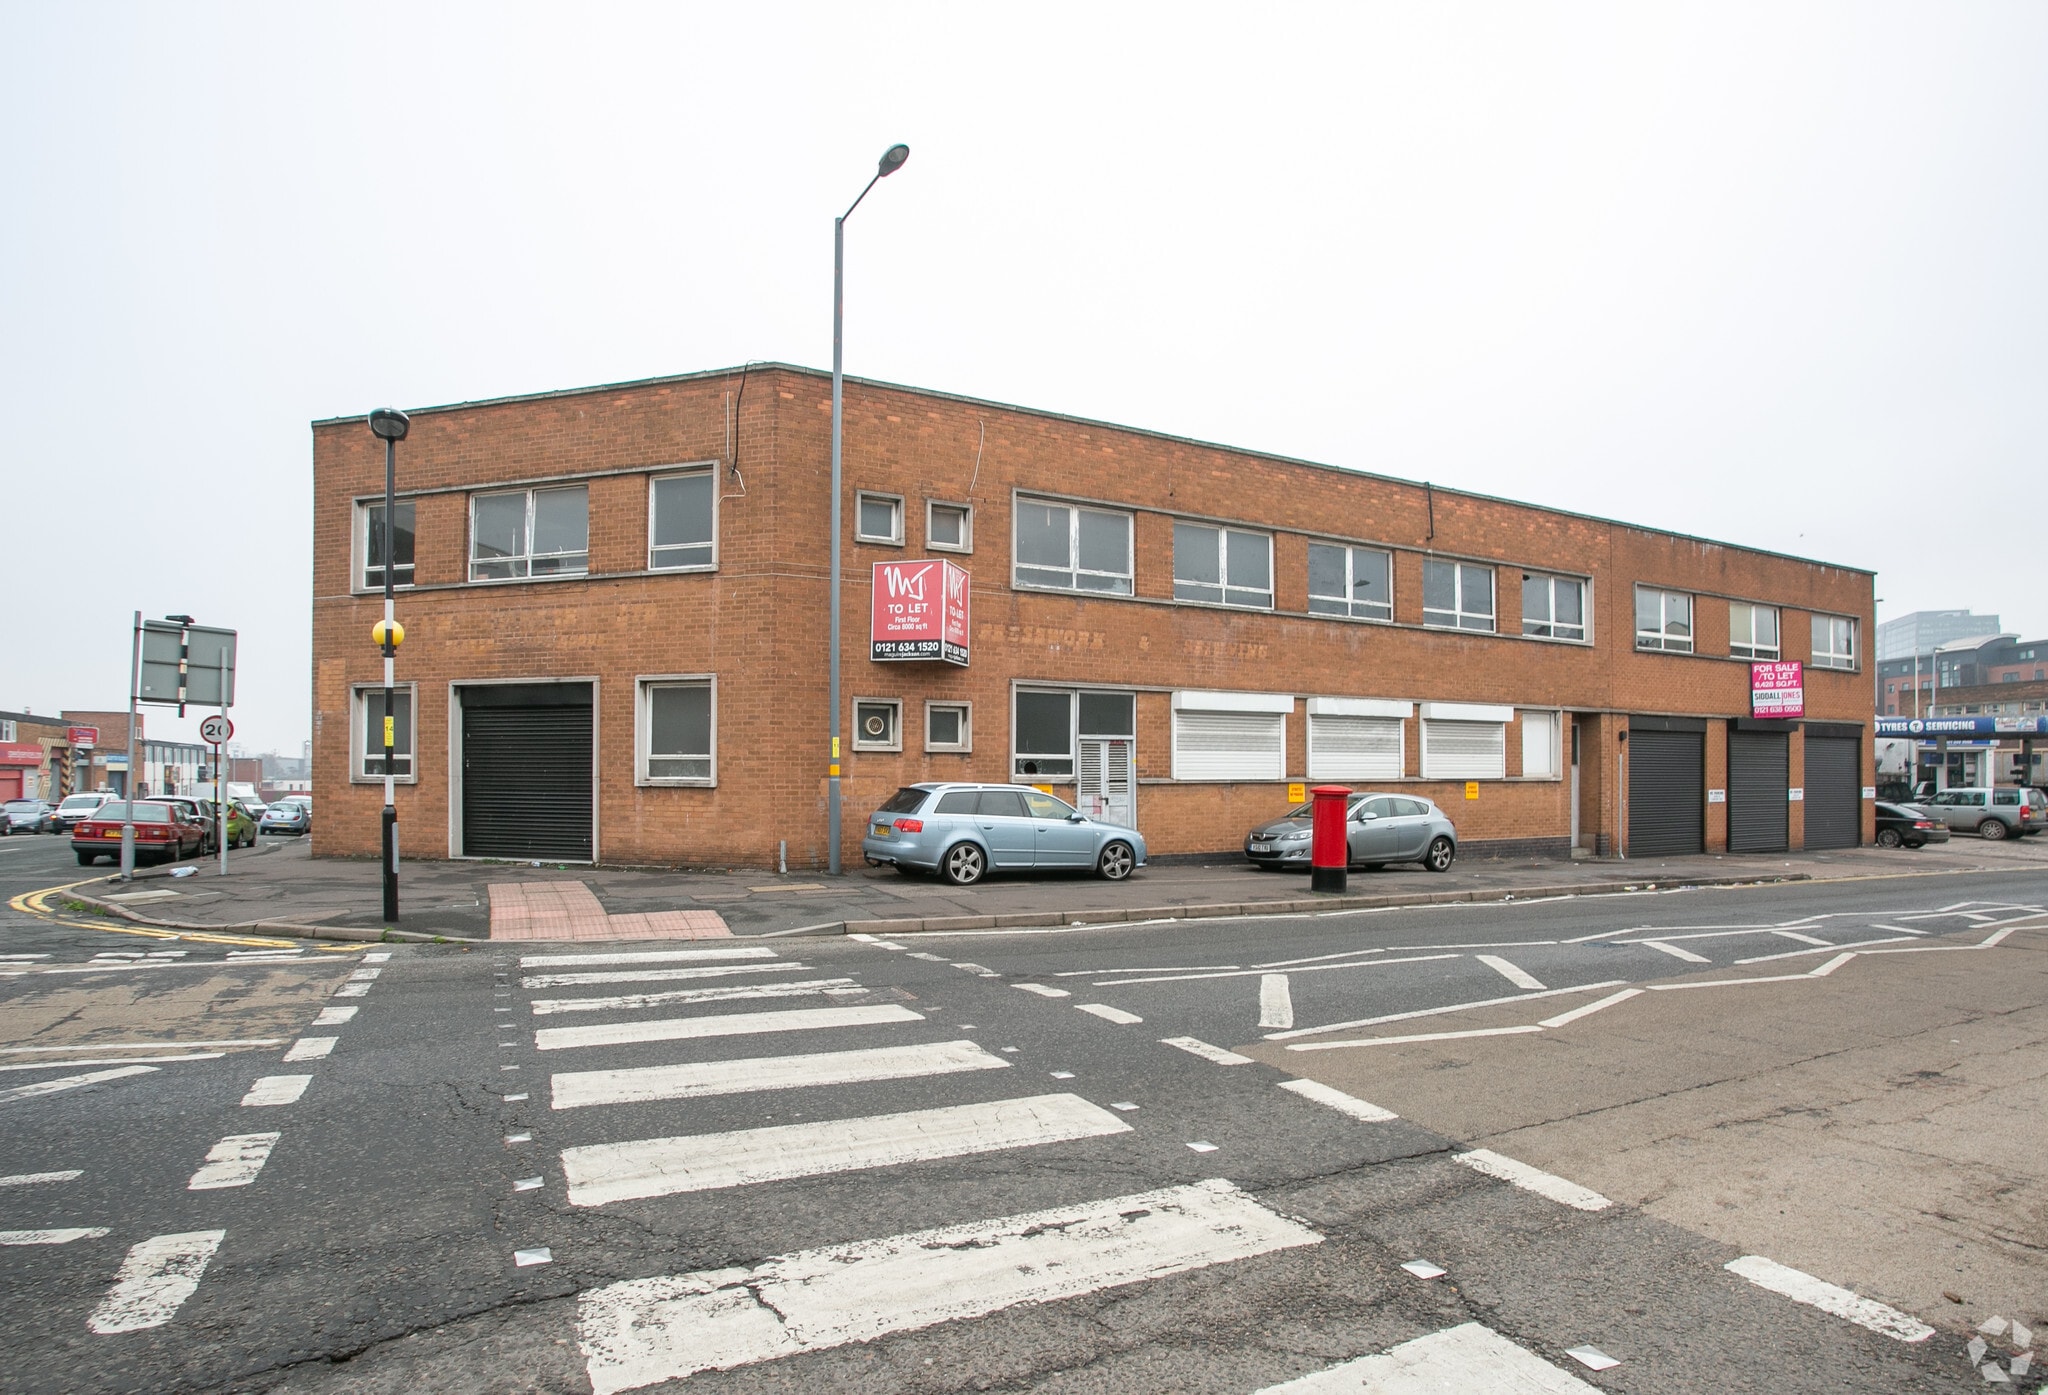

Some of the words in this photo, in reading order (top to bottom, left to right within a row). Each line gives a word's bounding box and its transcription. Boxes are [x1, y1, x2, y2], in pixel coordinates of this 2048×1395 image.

[888, 604, 904, 614] TO
[908, 603, 928, 613] LET
[949, 605, 956, 617] TO
[907, 615, 920, 623] Floor
[875, 642, 896, 652] 0121
[898, 642, 915, 652] 634
[917, 641, 939, 652] 1520
[1754, 665, 1773, 673] FOR
[1775, 663, 1799, 672] SALE
[1777, 671, 1795, 680] LET
[1754, 692, 1781, 701] SIDDALL
[205, 724, 230, 736] 20
[1880, 722, 1908, 732] TYRES
[1925, 720, 1975, 731] SERVICING
